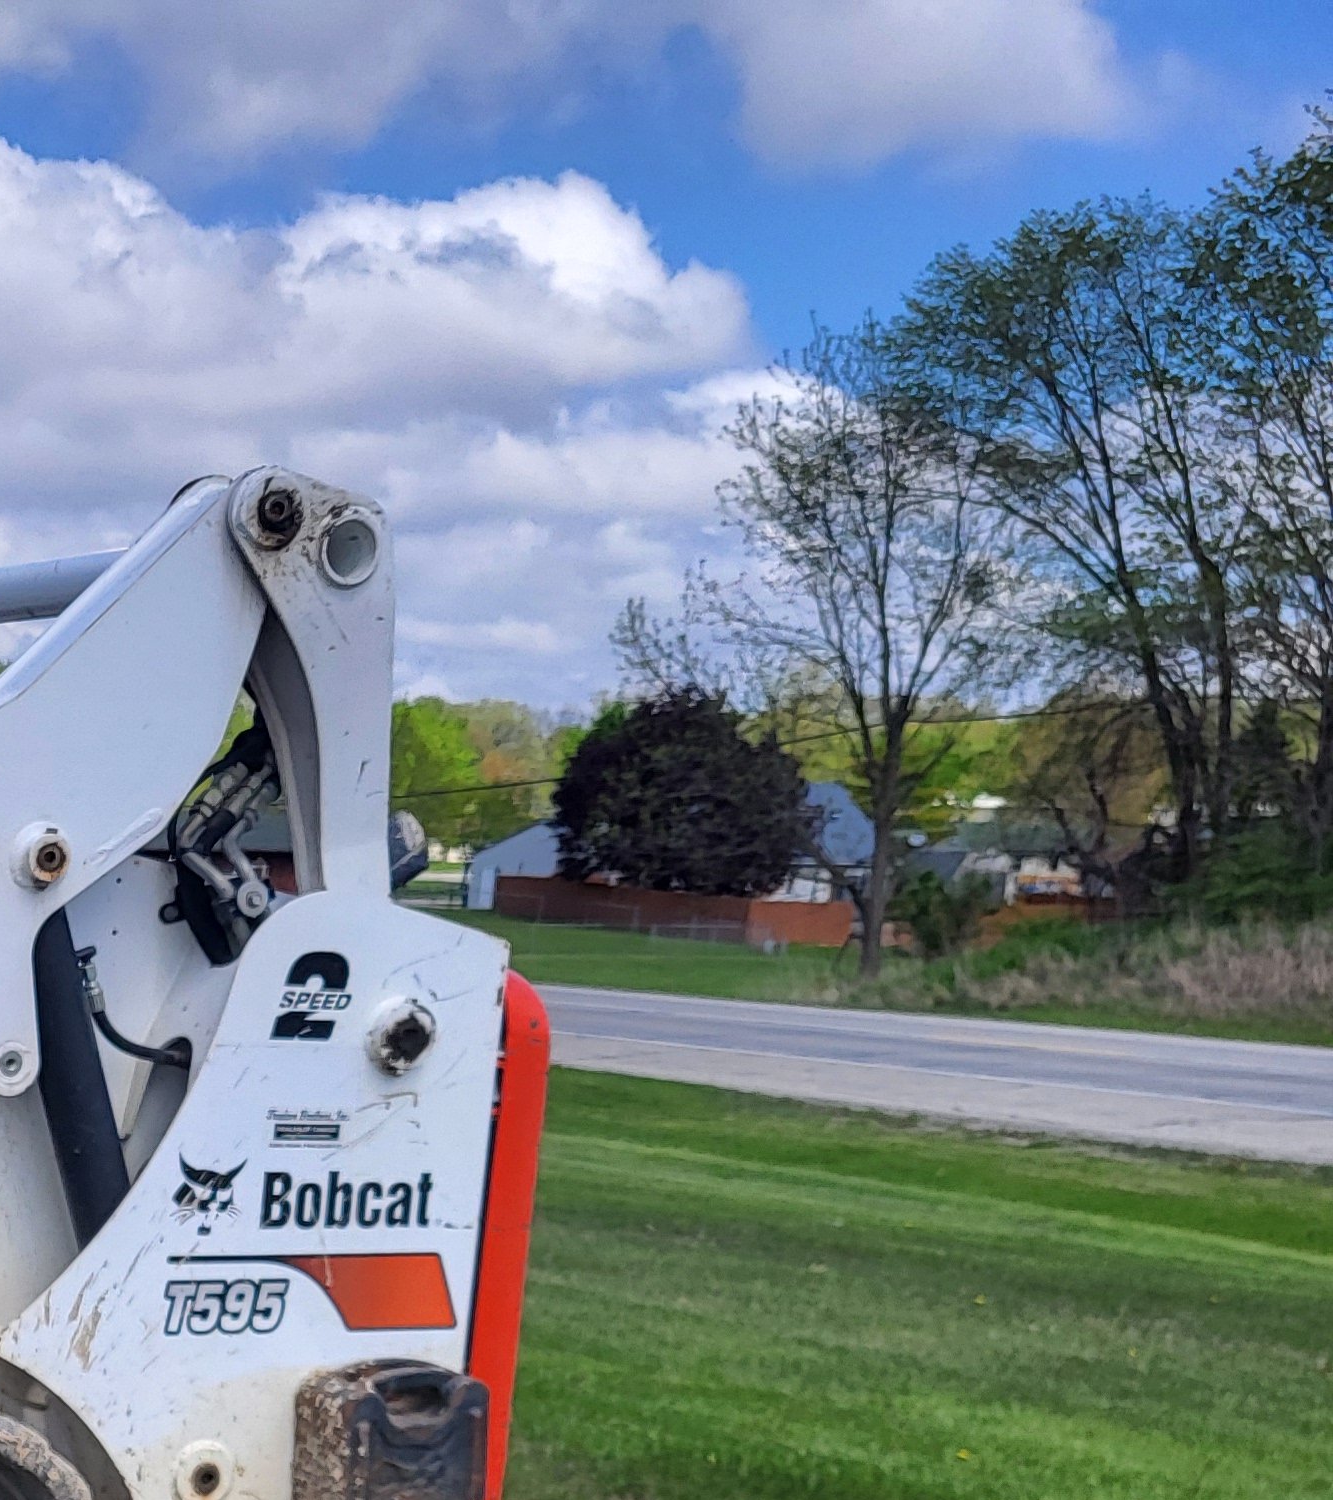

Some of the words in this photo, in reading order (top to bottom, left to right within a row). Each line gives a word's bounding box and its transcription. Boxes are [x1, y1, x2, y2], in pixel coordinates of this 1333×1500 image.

[270, 951, 349, 1041] 2
[279, 991, 352, 1010] SPEED
[260, 1171, 432, 1229] Bobcat
[164, 1279, 289, 1335] T595
